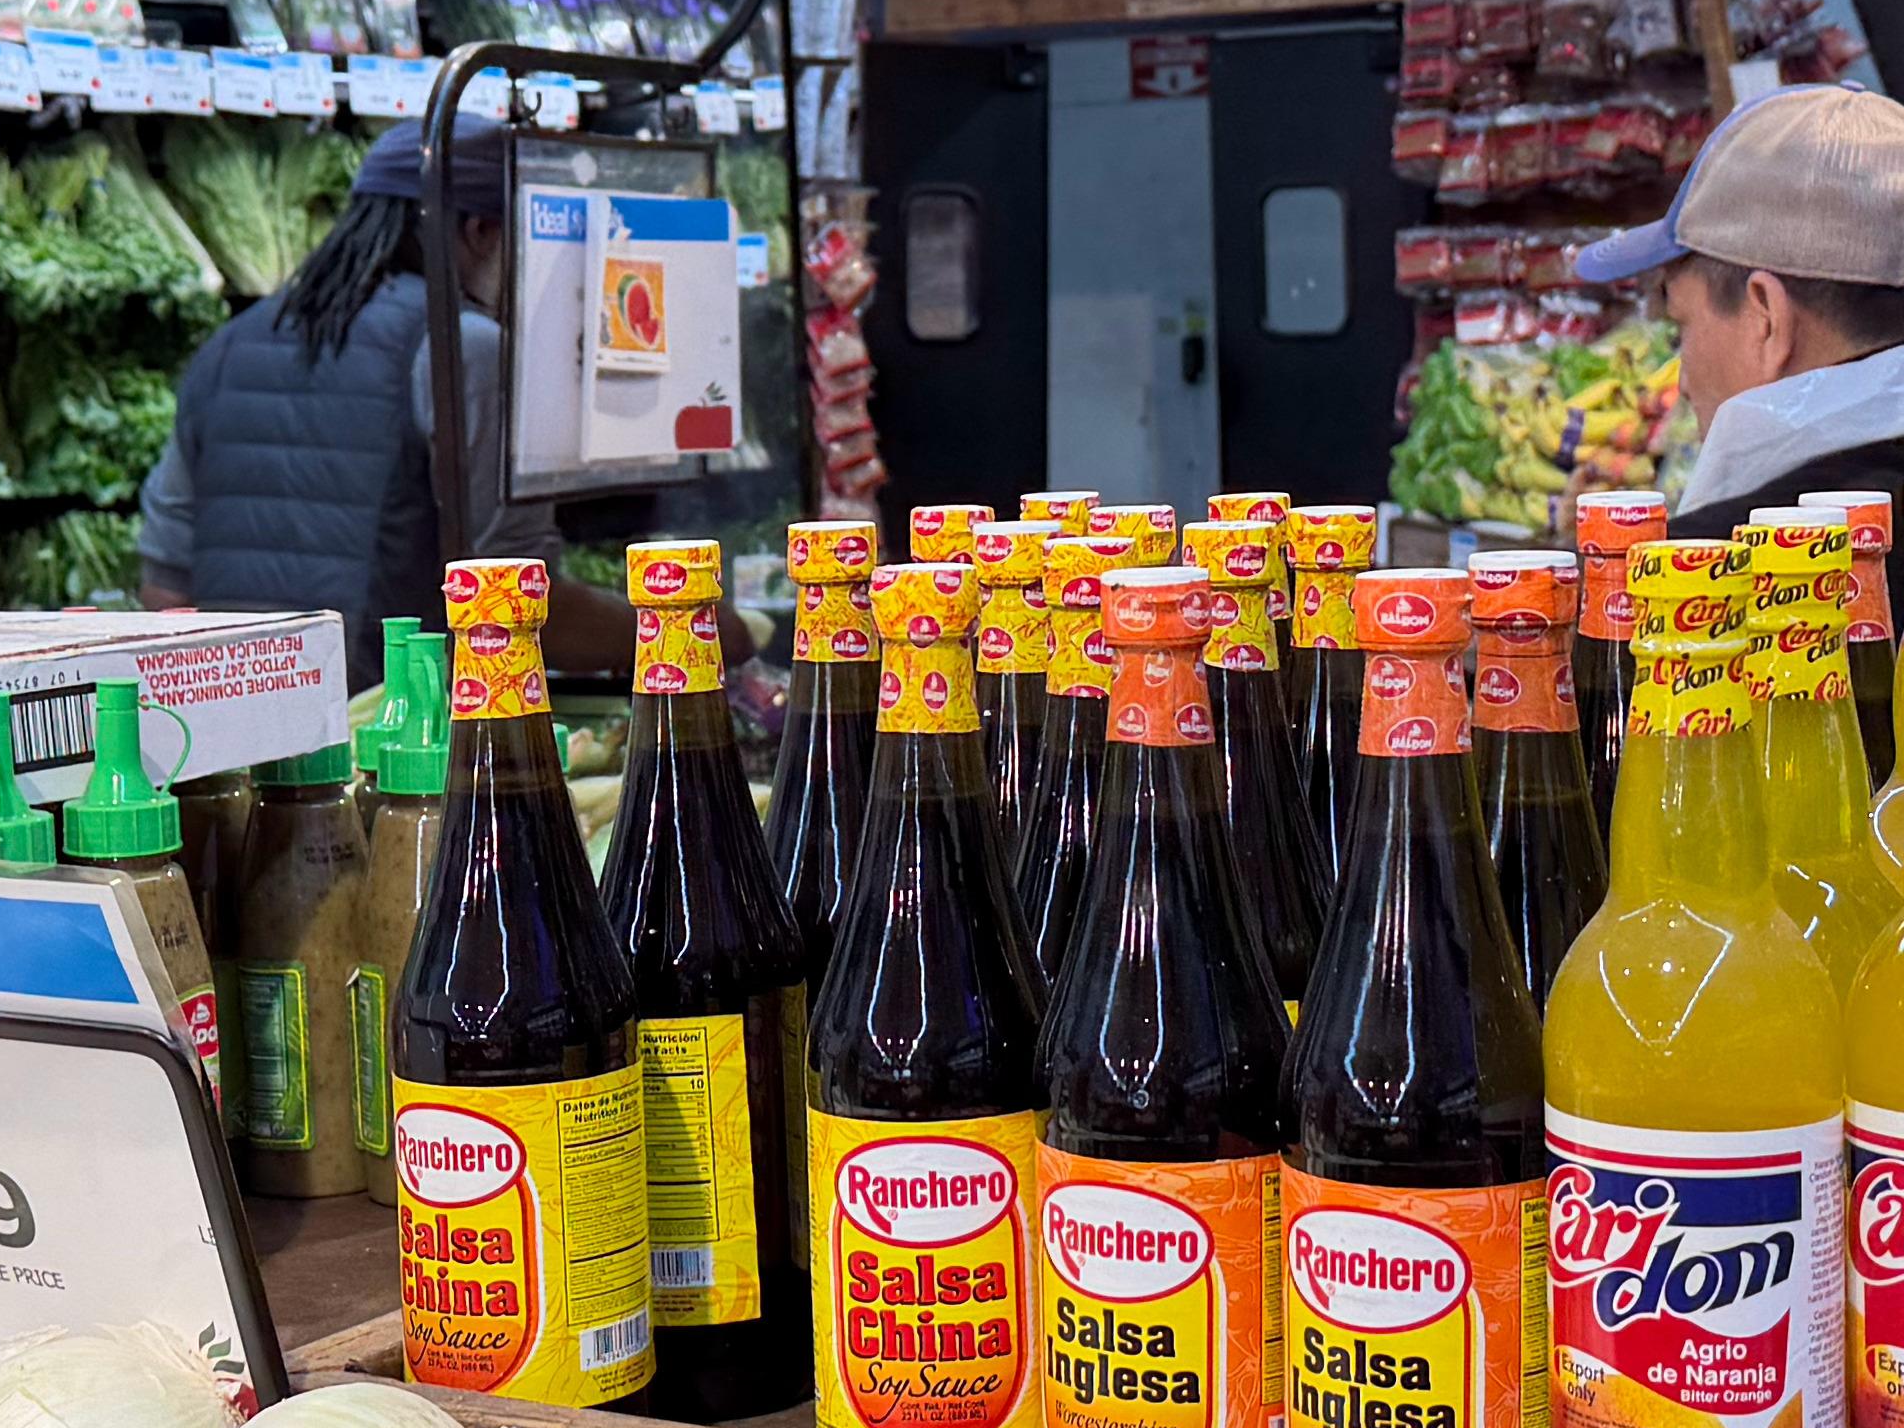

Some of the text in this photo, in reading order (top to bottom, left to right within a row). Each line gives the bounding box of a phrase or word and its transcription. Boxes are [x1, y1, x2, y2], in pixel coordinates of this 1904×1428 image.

[1379, 608, 1433, 628] BALDOM
[1674, 595, 1731, 632] Cari
[1756, 576, 1809, 610] dom
[135, 634, 304, 673] REPUBLICA DOMINICANA
[223, 662, 246, 679] 247
[1671, 662, 1724, 696] dom
[247, 668, 322, 695] BALTIMORE
[689, 1078, 705, 1090] 10
[396, 1124, 514, 1193] Ranchero
[848, 1163, 1007, 1235] Ranchero
[1546, 1164, 1679, 1286] Cari
[399, 1204, 516, 1266] Salsa
[1048, 1202, 1199, 1282] Ranchero
[12, 1265, 67, 1291] PRICE
[399, 1256, 520, 1318] China
[847, 1250, 1008, 1307] Salsa
[1295, 1226, 1457, 1312] Ranchero
[1596, 1231, 1795, 1331] dom
[405, 1309, 438, 1367] Soy
[431, 1313, 511, 1350] Sauce
[847, 1307, 1013, 1362] China
[1057, 1296, 1177, 1358] Salsa
[1679, 1338, 1749, 1366] Agrio
[1046, 1335, 1202, 1406] Inglesa
[1303, 1326, 1432, 1392] Salsa
[1561, 1351, 1606, 1385] Export
[1647, 1362, 1777, 1389] de Naranja
[859, 1361, 910, 1424] Soy
[908, 1364, 1003, 1399] Sauce
[1566, 1379, 1597, 1408] only
[1679, 1387, 1773, 1407] Bitter Orange
